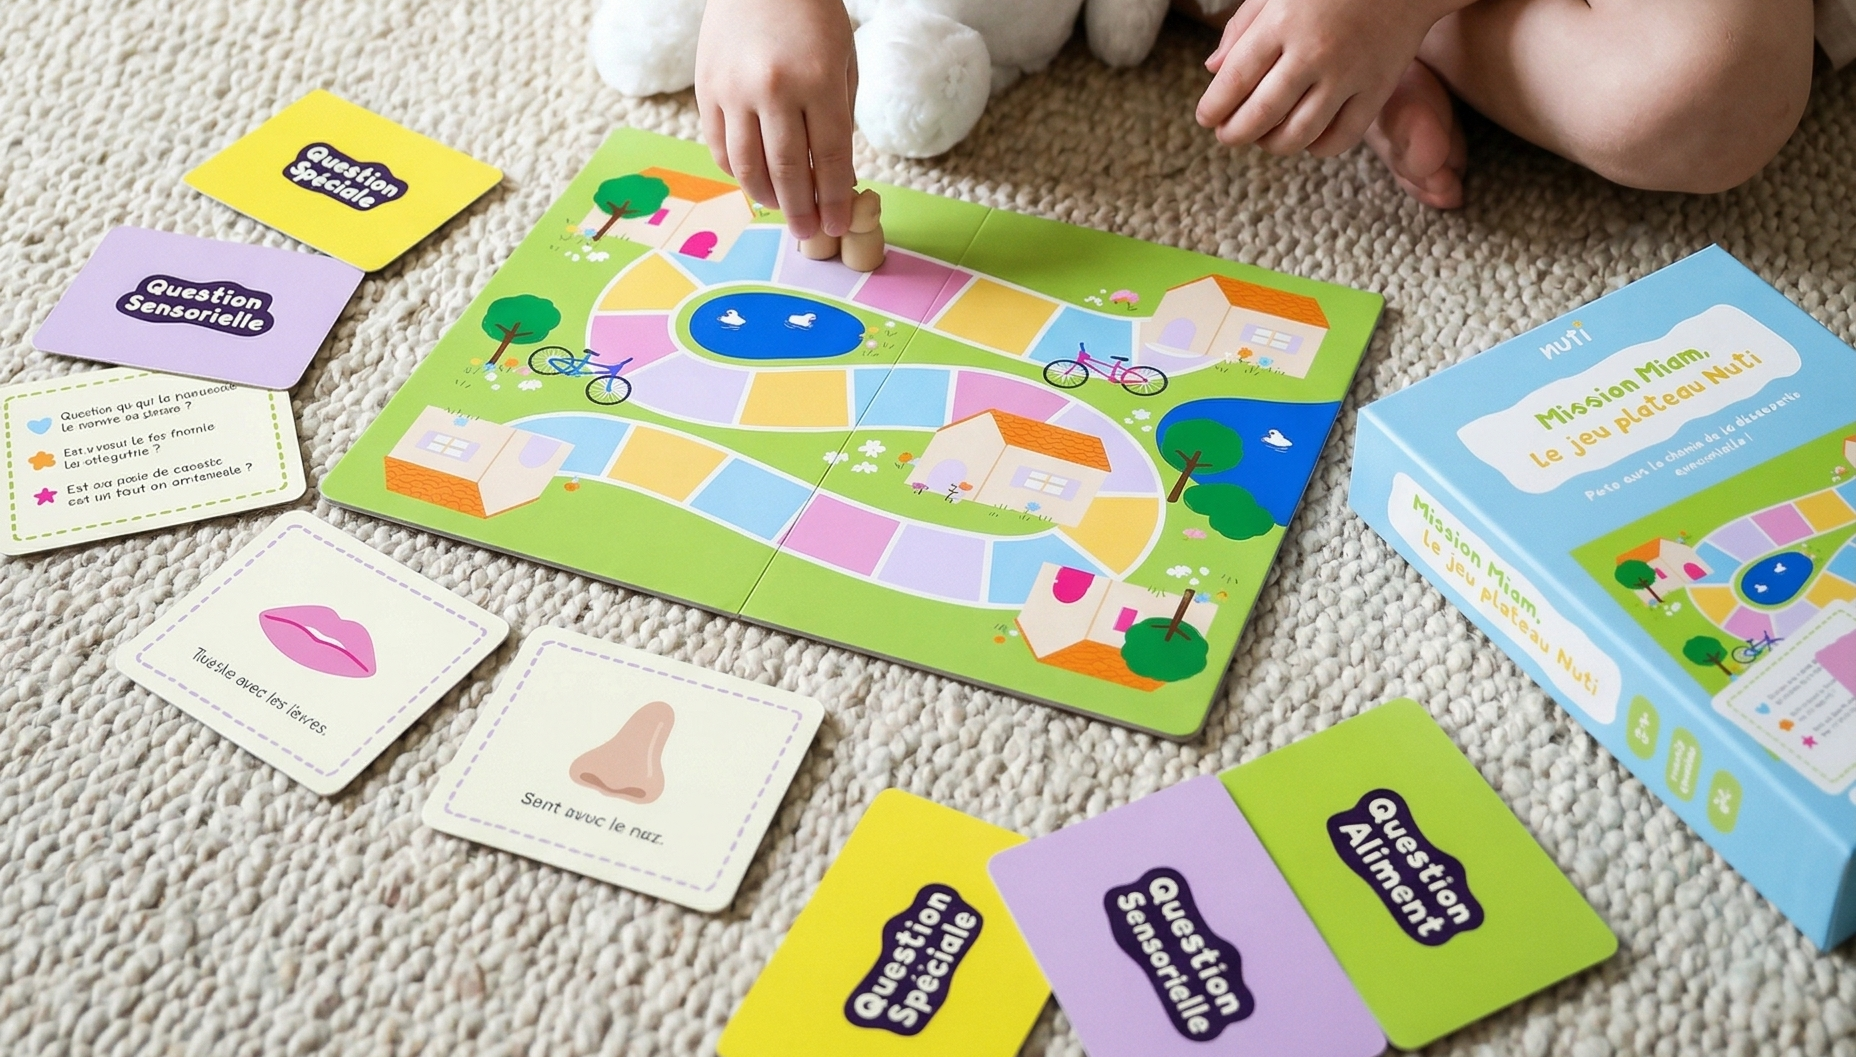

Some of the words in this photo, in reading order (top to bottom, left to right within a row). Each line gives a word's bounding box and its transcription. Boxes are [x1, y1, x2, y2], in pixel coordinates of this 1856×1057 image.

[289, 160, 376, 209] Spéciale
[306, 145, 399, 198] Question
[124, 294, 265, 332] Sensorielle
[146, 278, 264, 311] Question
[1533, 378, 1641, 430] Mission
[1633, 347, 1711, 384] Miam,
[1566, 426, 1612, 458] jeu
[1613, 380, 1707, 435] plateau
[1701, 349, 1764, 386] Nuti
[245, 462, 253, 472] ?
[1412, 493, 1481, 569] Mission
[1446, 552, 1476, 587] jeu
[1479, 587, 1550, 654] plateau
[1556, 647, 1600, 696] Nuti
[520, 791, 562, 814] Sent
[608, 817, 626, 833] le
[1338, 823, 1445, 938] Aliment
[1368, 797, 1471, 925] Question
[853, 892, 952, 1020] Question
[887, 911, 977, 1029] Spéciale
[1116, 891, 1211, 1035] Sensorielle
[1148, 876, 1241, 1017] Question
